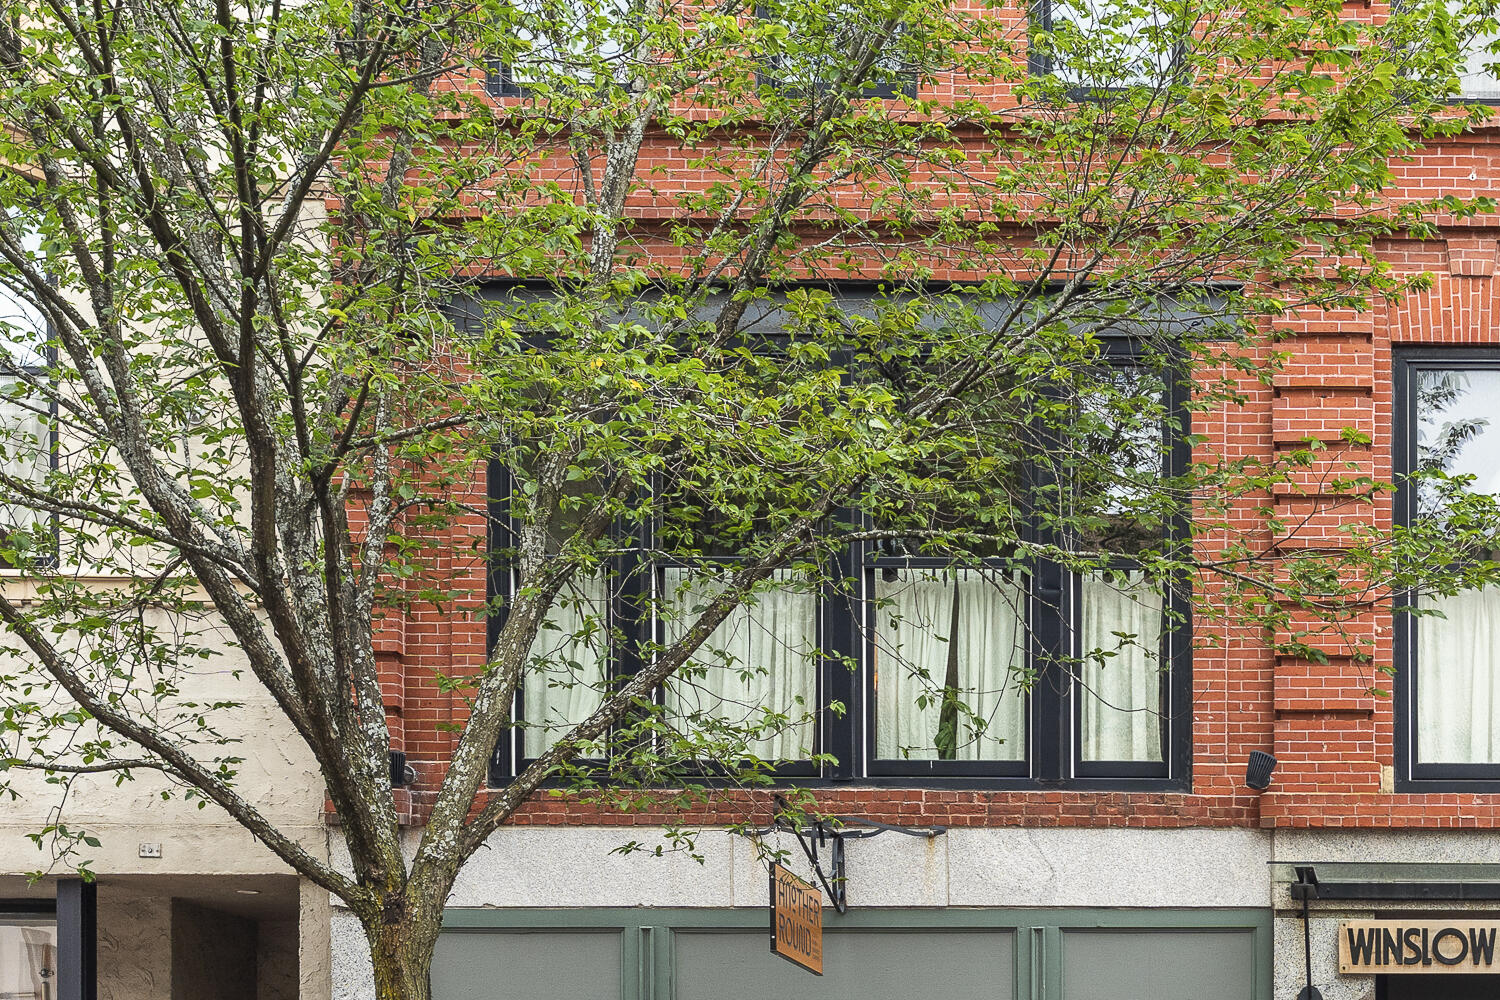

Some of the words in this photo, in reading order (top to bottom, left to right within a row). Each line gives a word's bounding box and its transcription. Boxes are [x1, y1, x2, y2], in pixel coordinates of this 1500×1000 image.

[778, 876, 820, 929] ANOTHER
[778, 912, 812, 957] ROUND
[1347, 927, 1497, 966] WINSLOW
